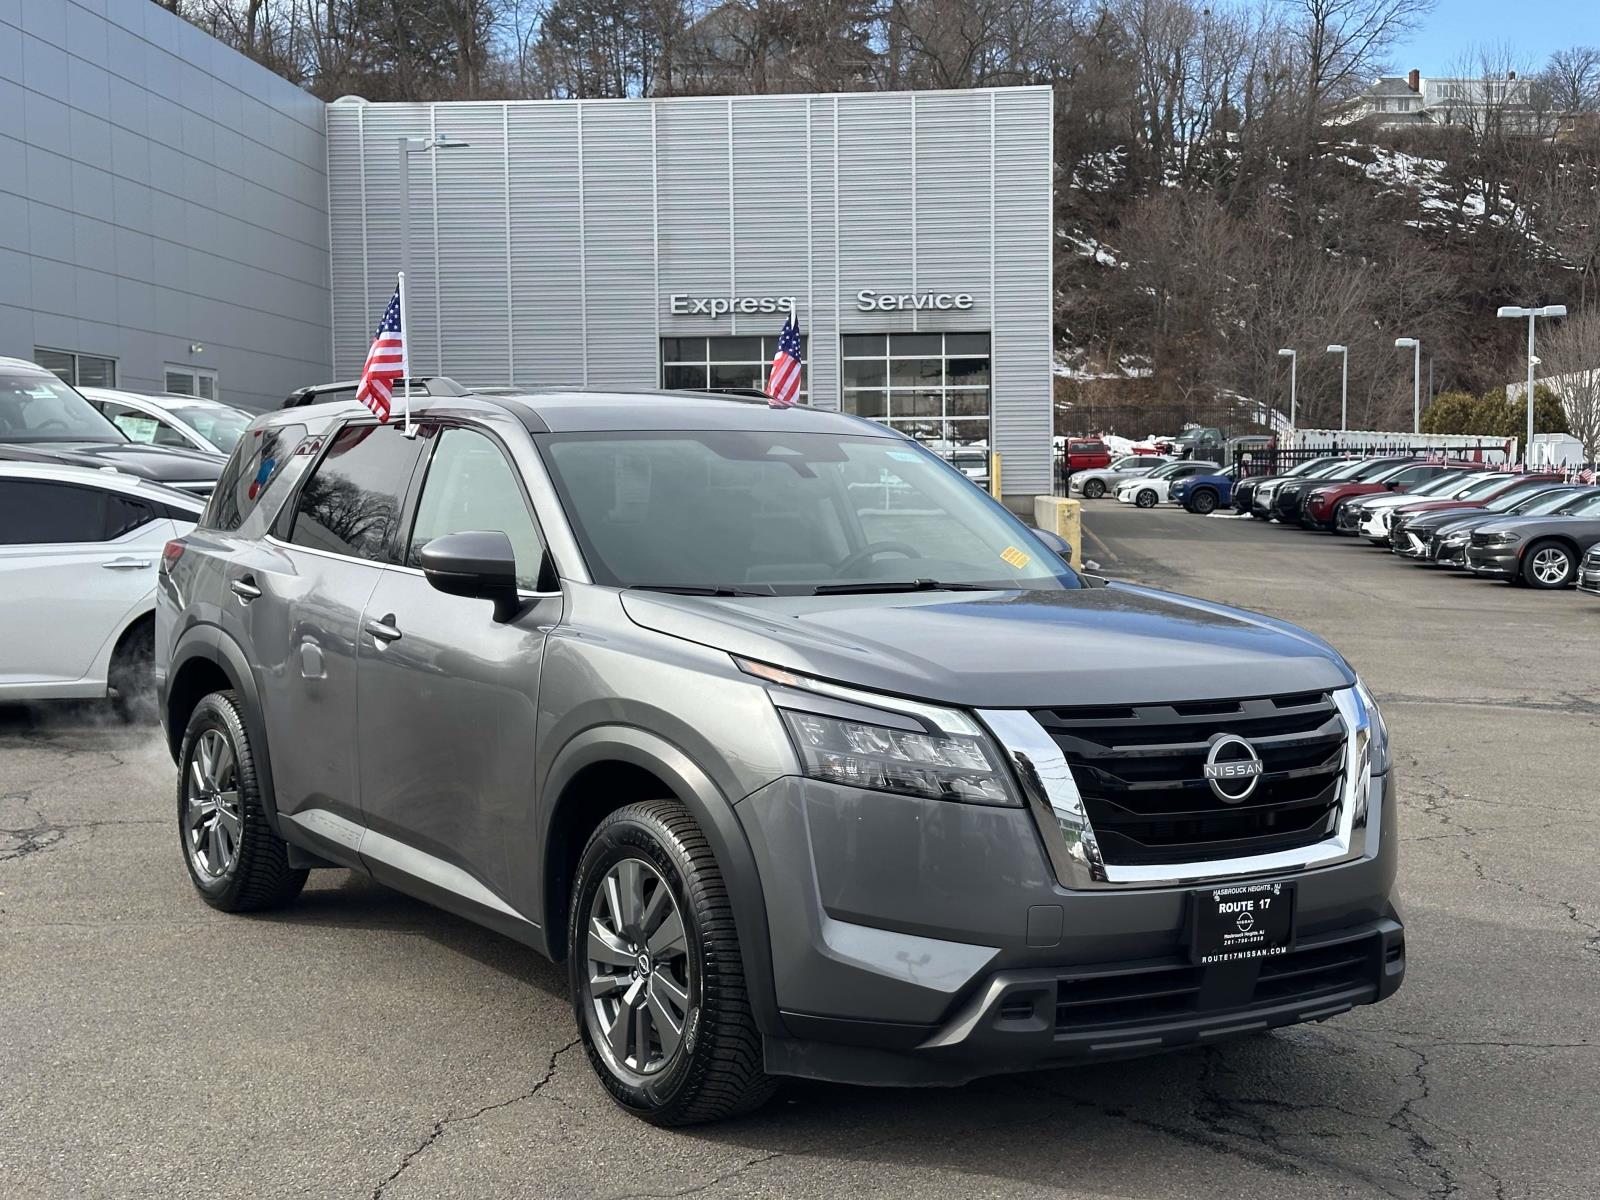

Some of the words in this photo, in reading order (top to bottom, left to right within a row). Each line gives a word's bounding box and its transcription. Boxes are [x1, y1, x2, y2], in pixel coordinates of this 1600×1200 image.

[670, 293, 794, 319] Express
[857, 289, 973, 311] Service
[1206, 763, 1262, 777] NISSAN
[1219, 900, 1254, 913] ROUTE
[1259, 899, 1270, 909] 17
[1202, 947, 1286, 963] ROUTE17NISSAN.COM
